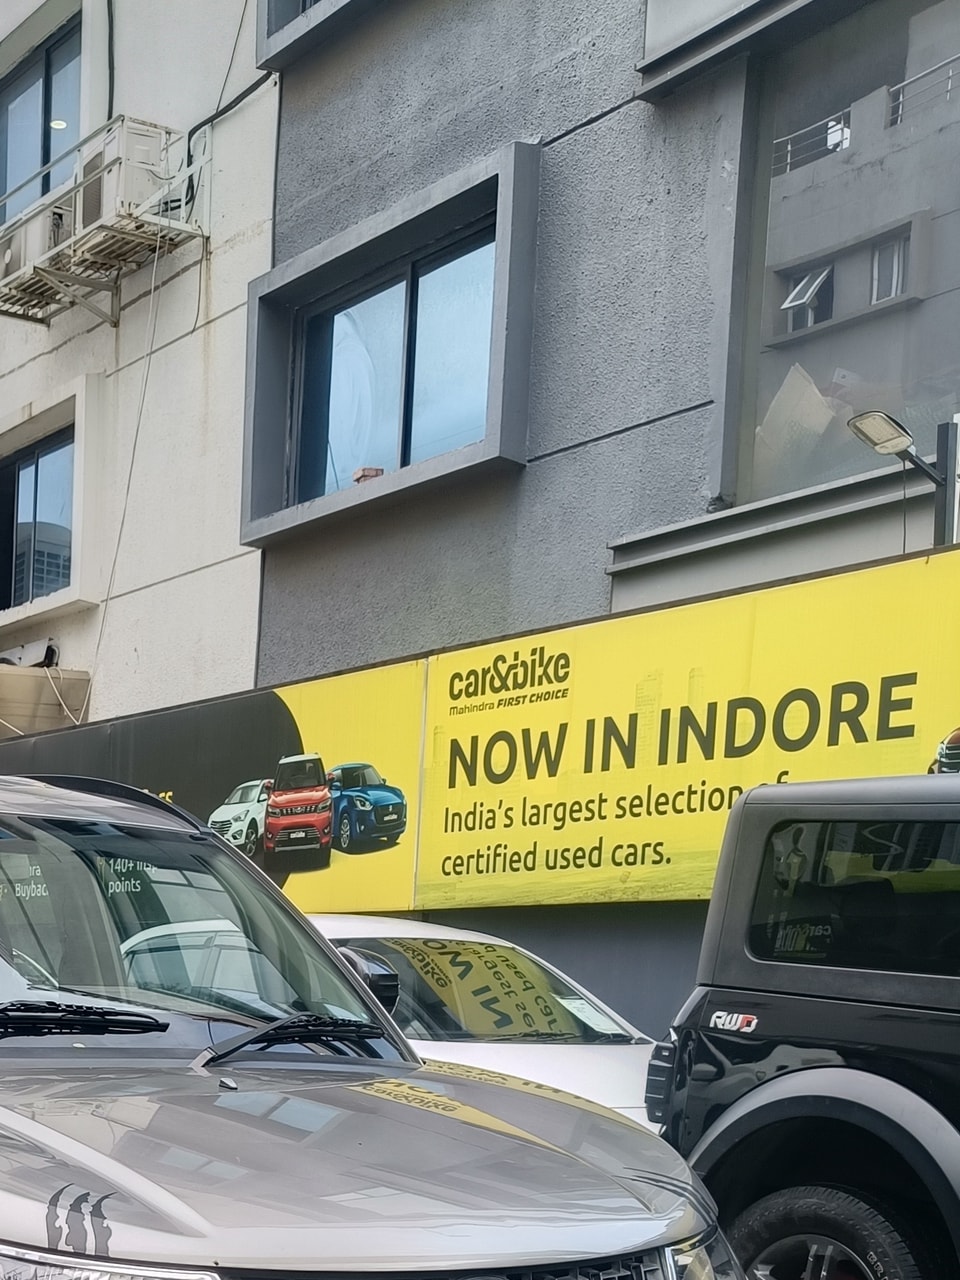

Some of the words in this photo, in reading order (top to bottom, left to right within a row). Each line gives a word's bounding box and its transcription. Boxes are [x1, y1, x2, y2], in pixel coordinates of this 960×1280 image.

[449, 646, 570, 701] car&bike
[449, 701, 495, 716] Mahindra
[496, 694, 528, 709] FIRST
[529, 688, 569, 704] CHOICE
[448, 722, 569, 789] NOW
[583, 713, 638, 774] IN
[657, 672, 918, 766] INDORE
[521, 792, 608, 831] largest
[441, 841, 538, 877] certified
[545, 836, 604, 871] used
[611, 841, 672, 868] cars.
[108, 876, 141, 897] points
[709, 1011, 758, 1033] RWD
